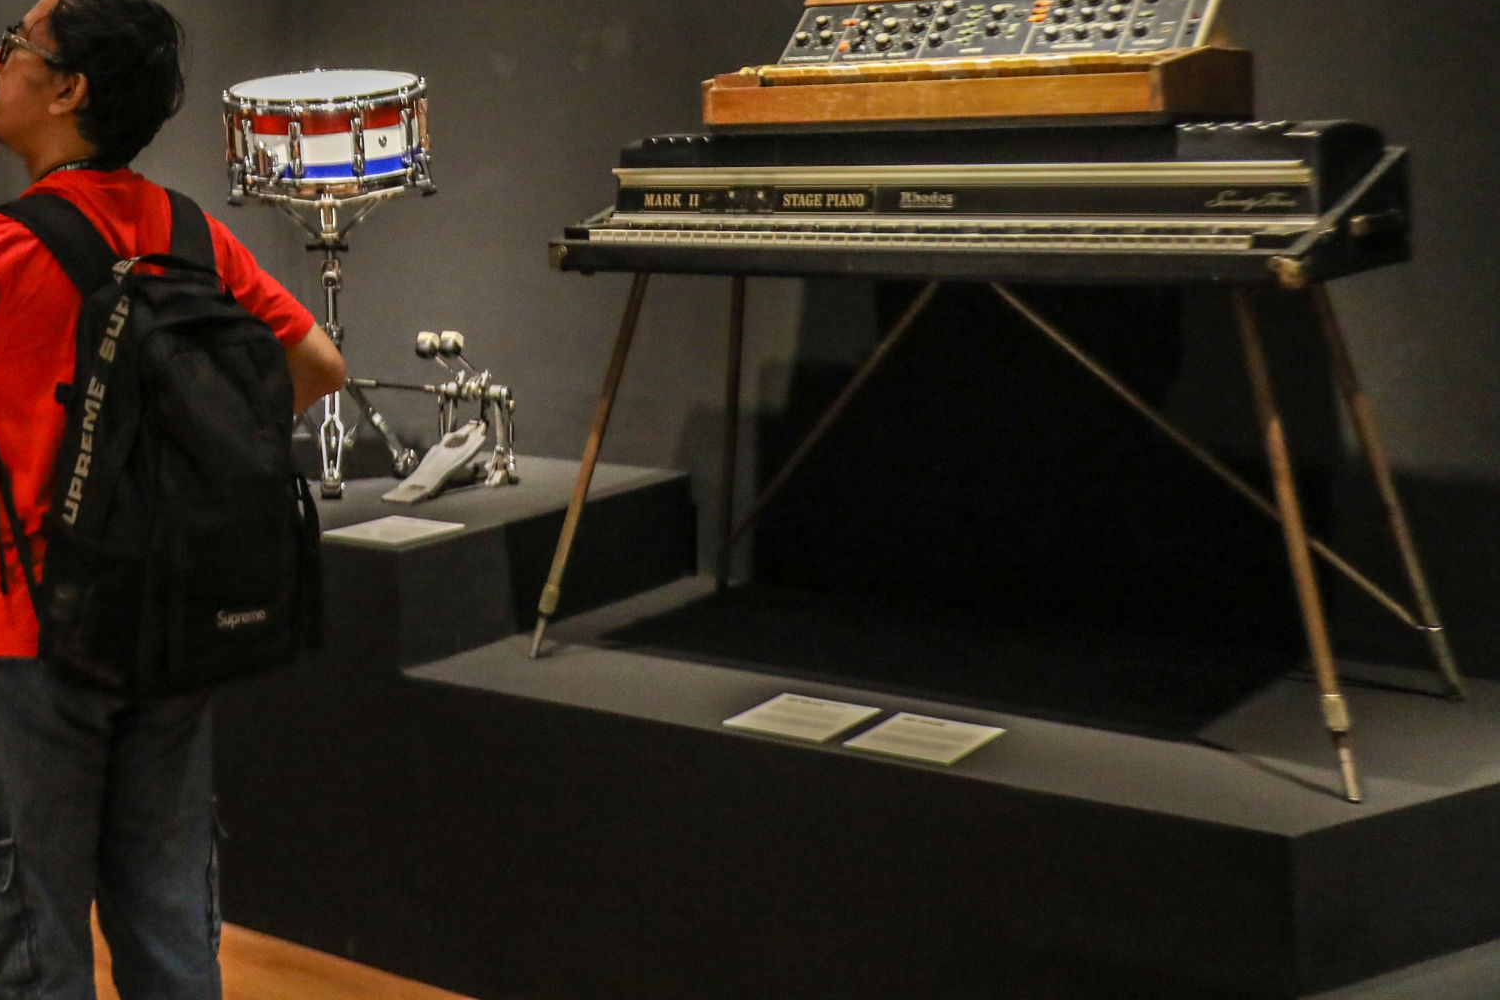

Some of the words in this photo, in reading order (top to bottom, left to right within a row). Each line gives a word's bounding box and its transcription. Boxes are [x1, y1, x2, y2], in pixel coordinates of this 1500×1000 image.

[644, 193, 682, 207] MARK
[688, 193, 699, 207] II
[783, 193, 822, 207] STAGE
[826, 193, 865, 207] PIANO
[900, 191, 953, 204] Rhodes
[217, 609, 267, 631] Supreme
